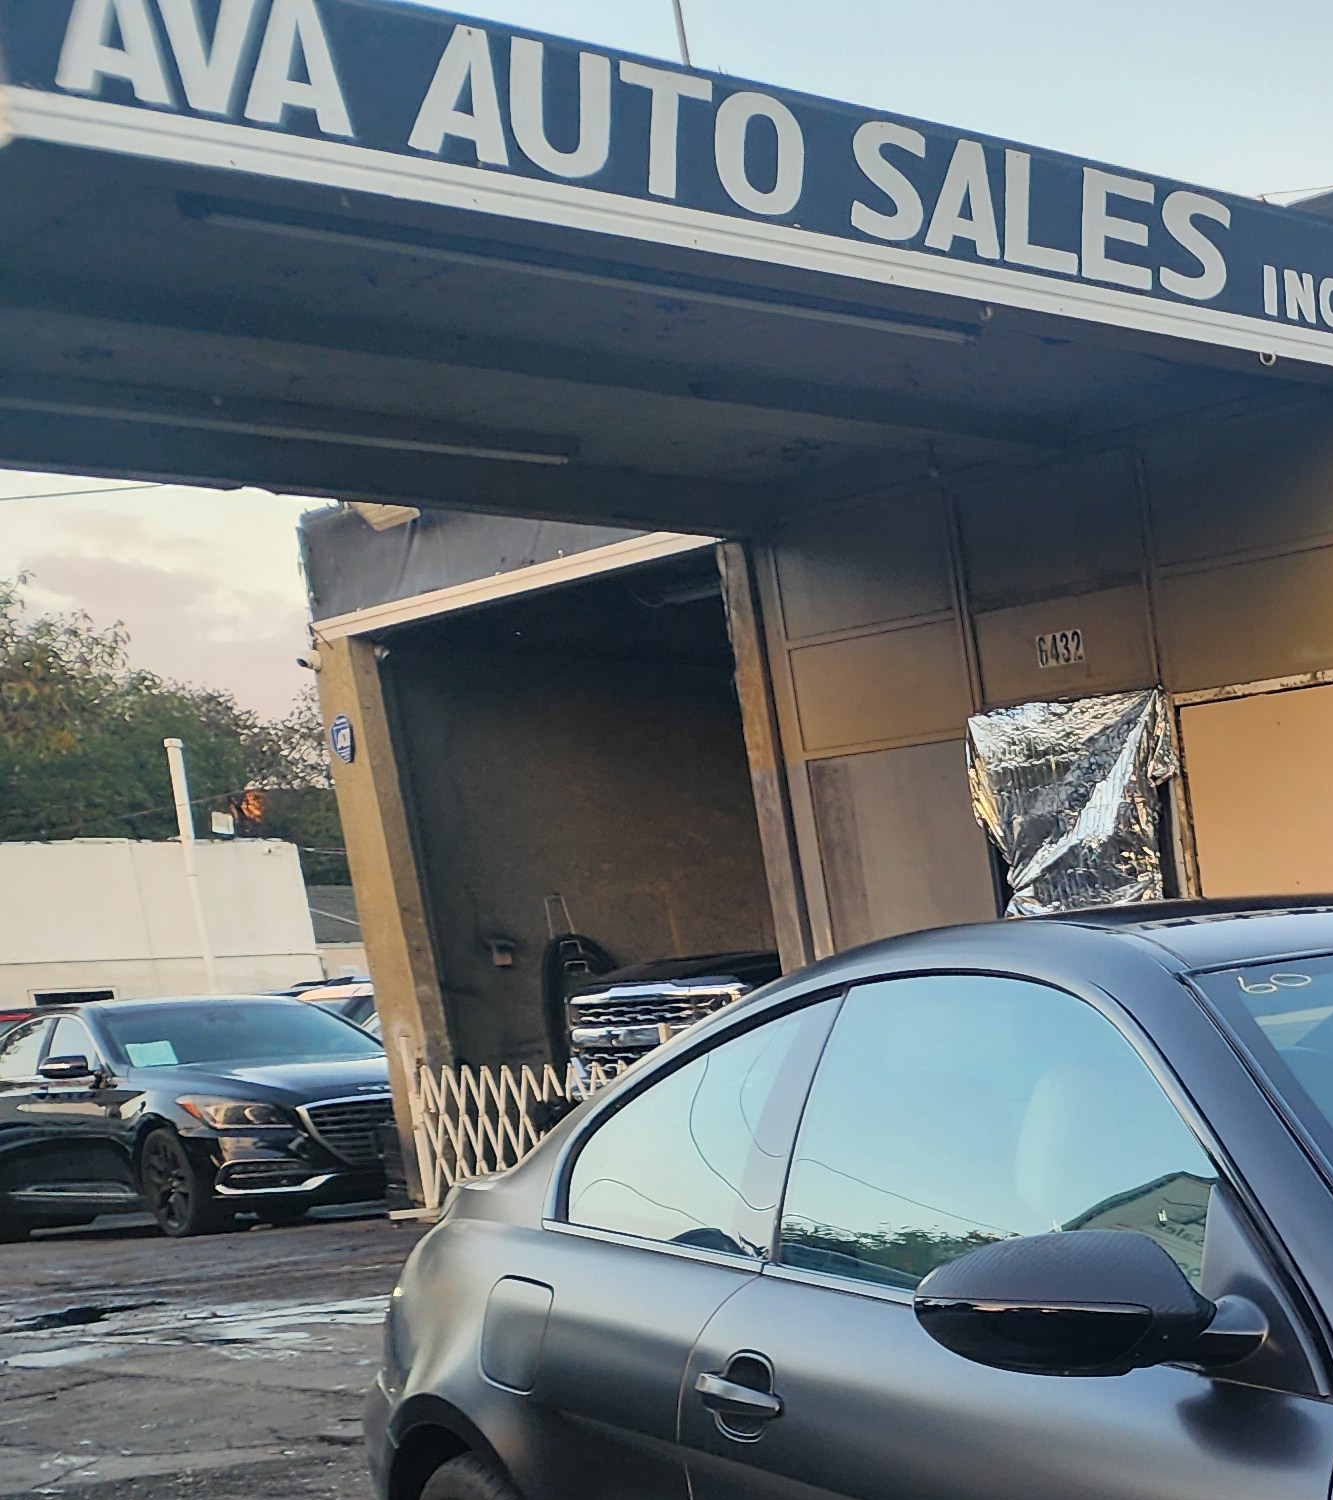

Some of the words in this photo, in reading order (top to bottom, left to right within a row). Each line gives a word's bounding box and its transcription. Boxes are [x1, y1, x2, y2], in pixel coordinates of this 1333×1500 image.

[54, 0, 355, 138] AVA
[406, 23, 805, 216] AUTO
[850, 120, 1232, 301] SALES
[1037, 630, 1084, 667] 6432
